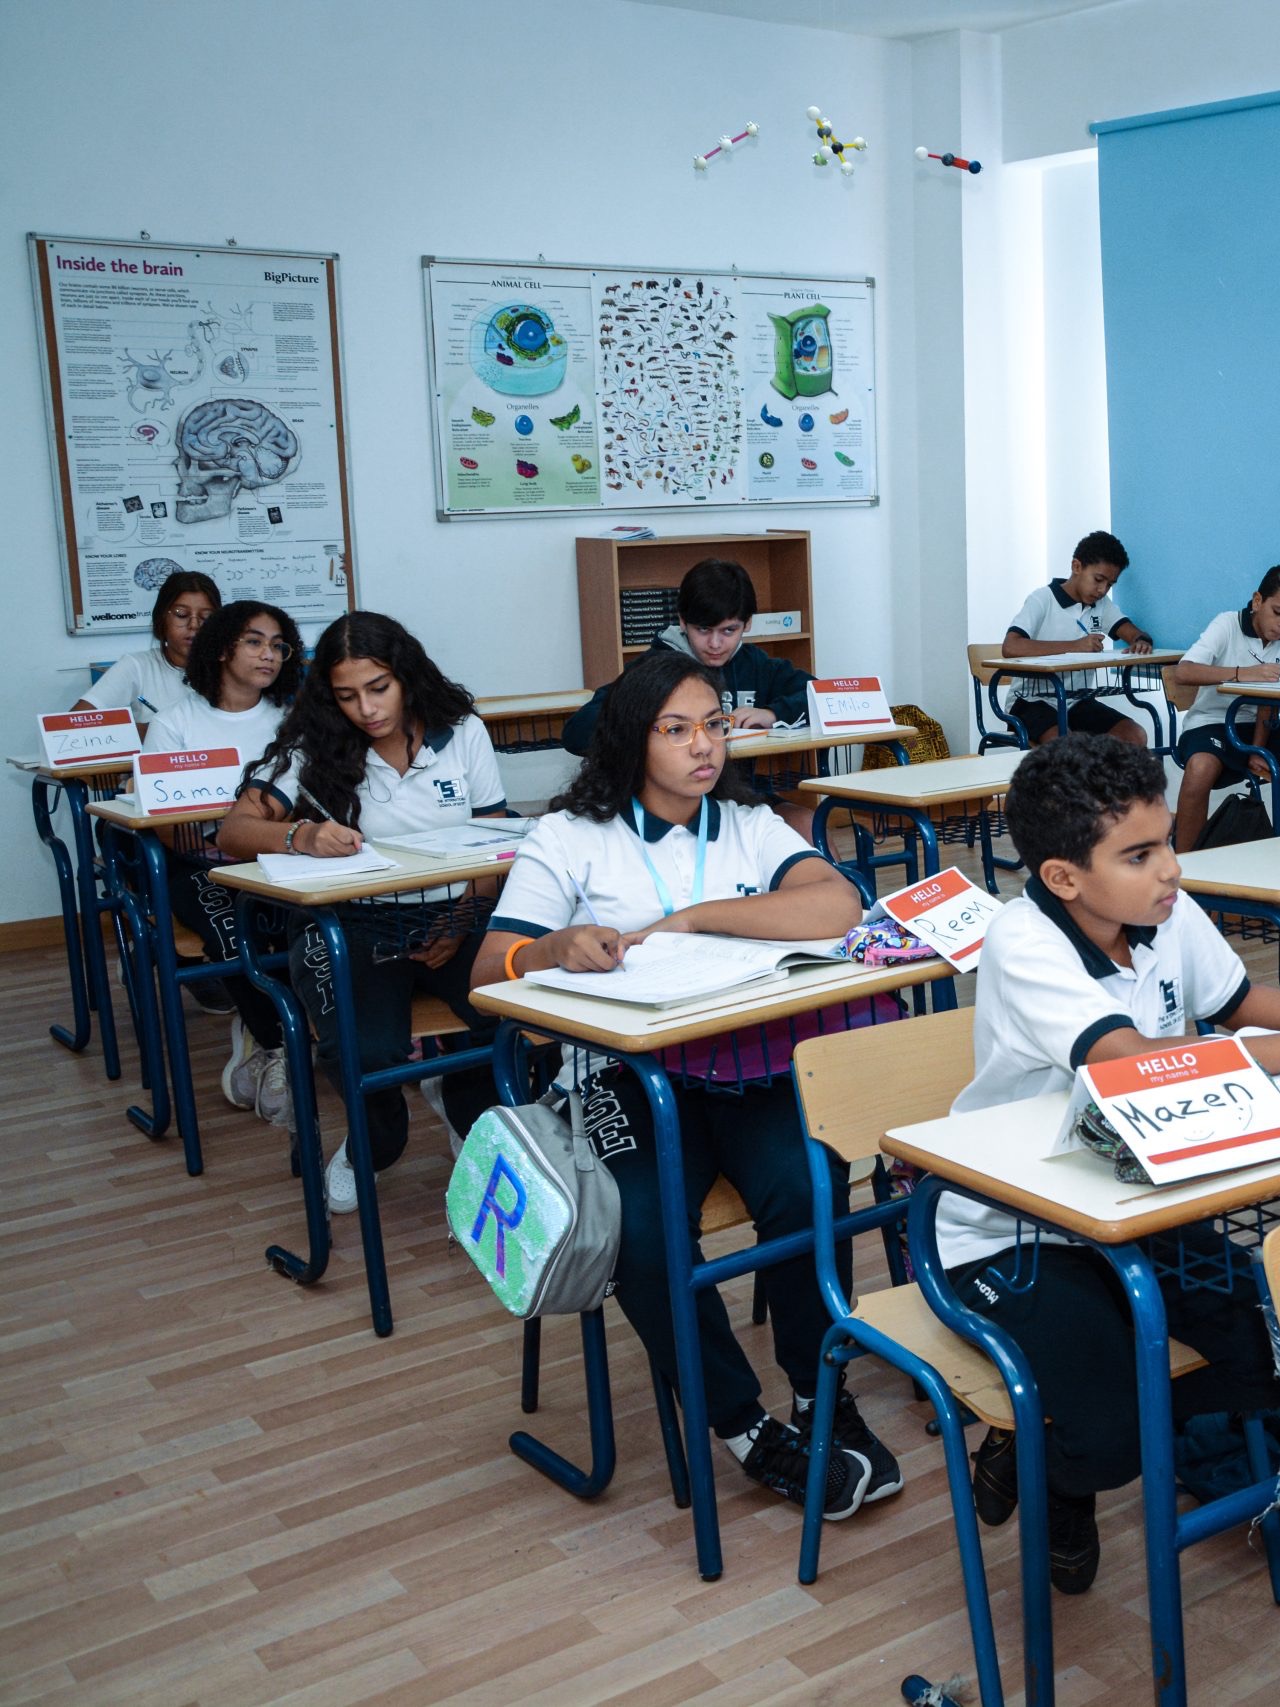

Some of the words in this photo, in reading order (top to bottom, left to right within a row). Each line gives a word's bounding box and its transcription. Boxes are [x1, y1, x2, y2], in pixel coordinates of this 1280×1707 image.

[56, 255, 106, 272] Inside
[110, 258, 138, 274] the
[143, 260, 183, 276] brain
[264, 271, 319, 284] BigPicture
[491, 280, 522, 288] ANIMAL
[506, 403, 540, 412] Organelles
[91, 612, 137, 621] wellcome
[70, 714, 104, 724] HELLO
[170, 754, 208, 763] HELLO
[153, 779, 230, 803] Sama
[910, 884, 942, 903] HELLO
[1137, 1053, 1197, 1076] HELLO
[1150, 1075, 1164, 1083] my
[1165, 1070, 1190, 1079] name
[1112, 1082, 1254, 1139] Mazen
[471, 1152, 527, 1281] R
[974, 1278, 999, 1304] ISE
